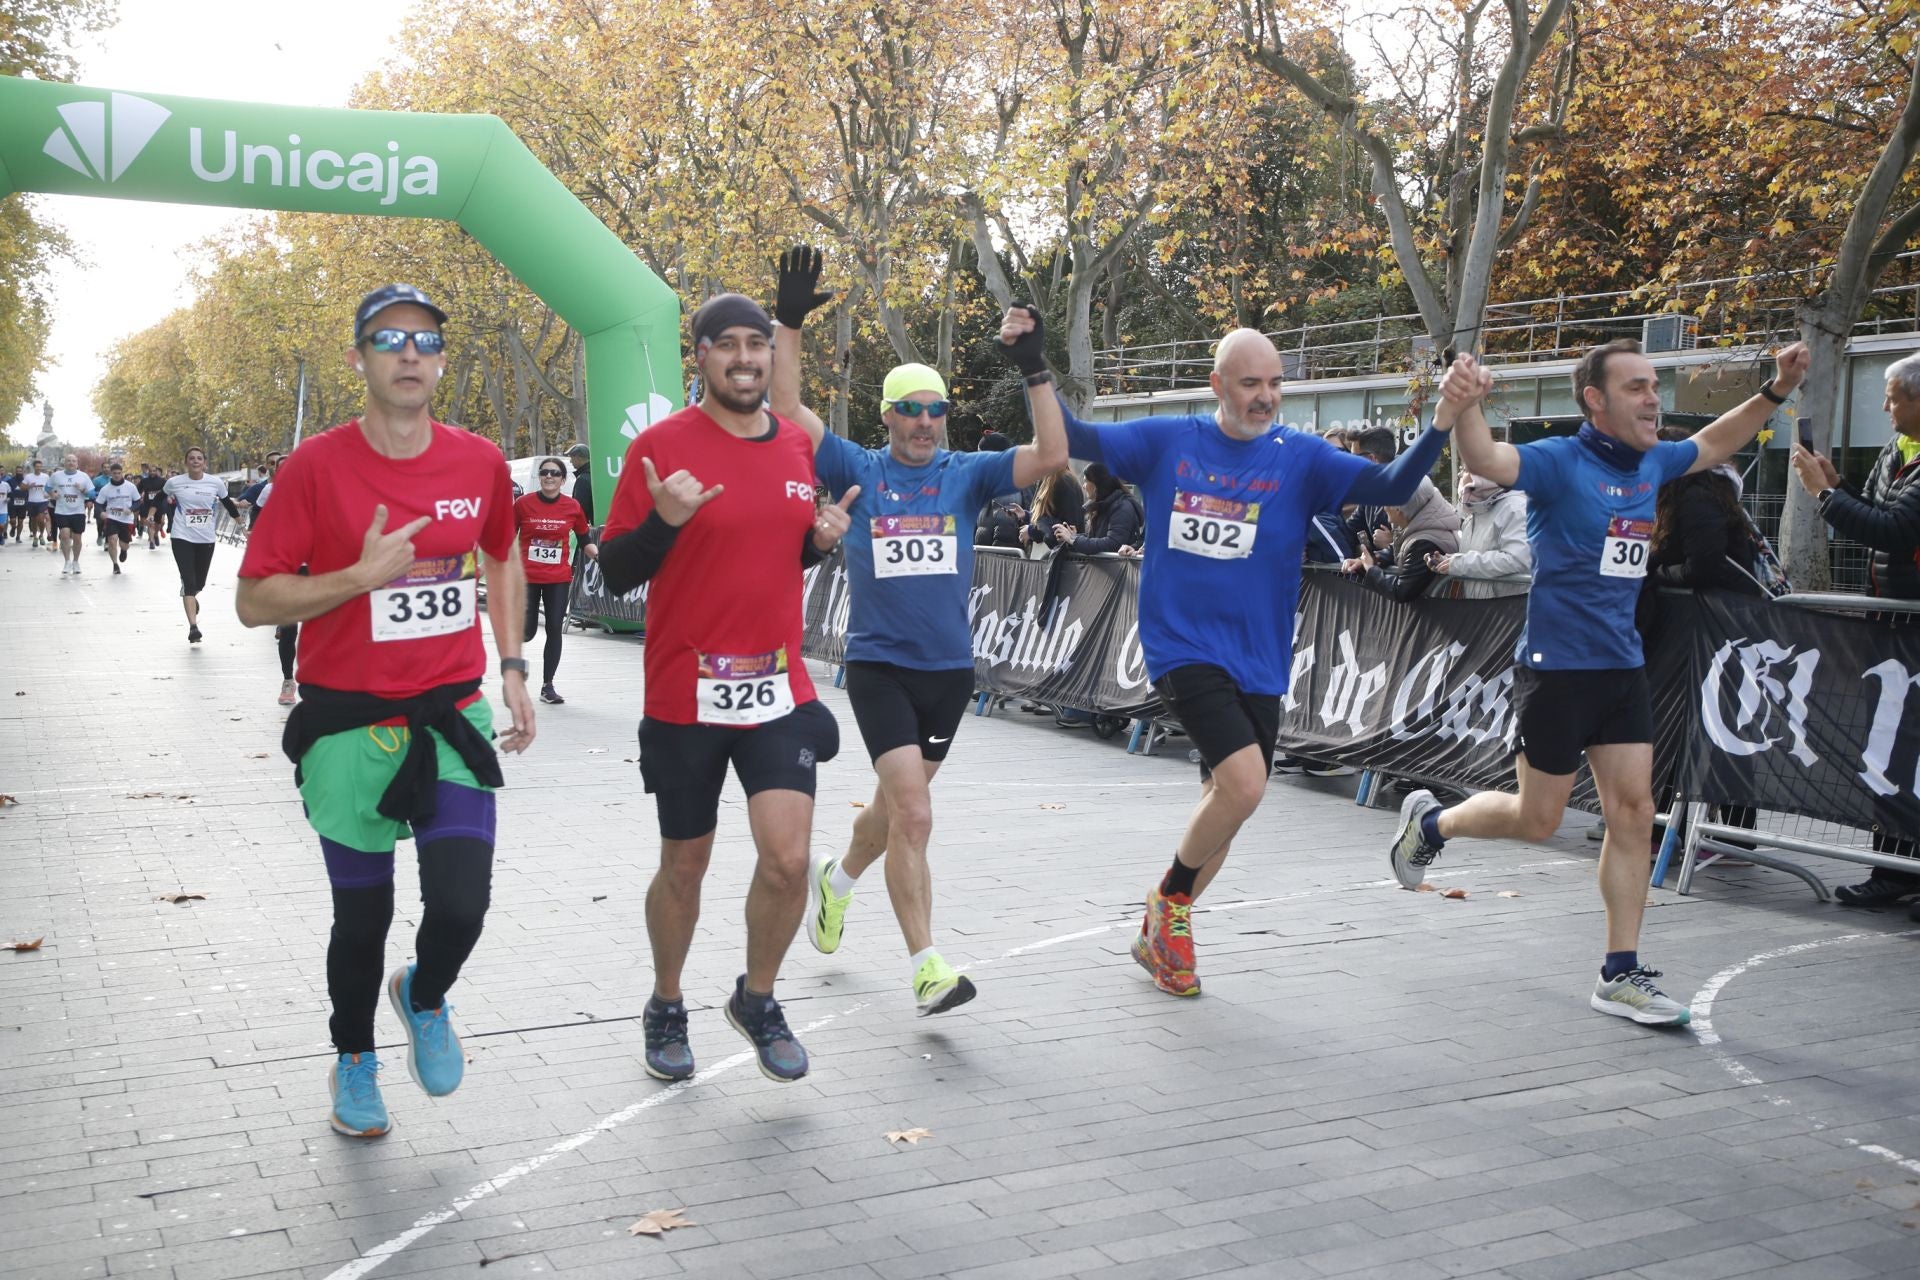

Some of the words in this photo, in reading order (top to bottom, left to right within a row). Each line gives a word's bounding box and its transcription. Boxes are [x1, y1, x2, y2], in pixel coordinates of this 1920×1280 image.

[189, 126, 439, 205] Unicaja
[189, 515, 208, 524] 257
[1181, 517, 1242, 549] 302
[533, 548, 557, 559] 134
[885, 538, 944, 564] 303
[1612, 541, 1648, 567] 30
[387, 586, 462, 623] 338
[711, 679, 776, 711] 326
[1318, 629, 1388, 738] de
